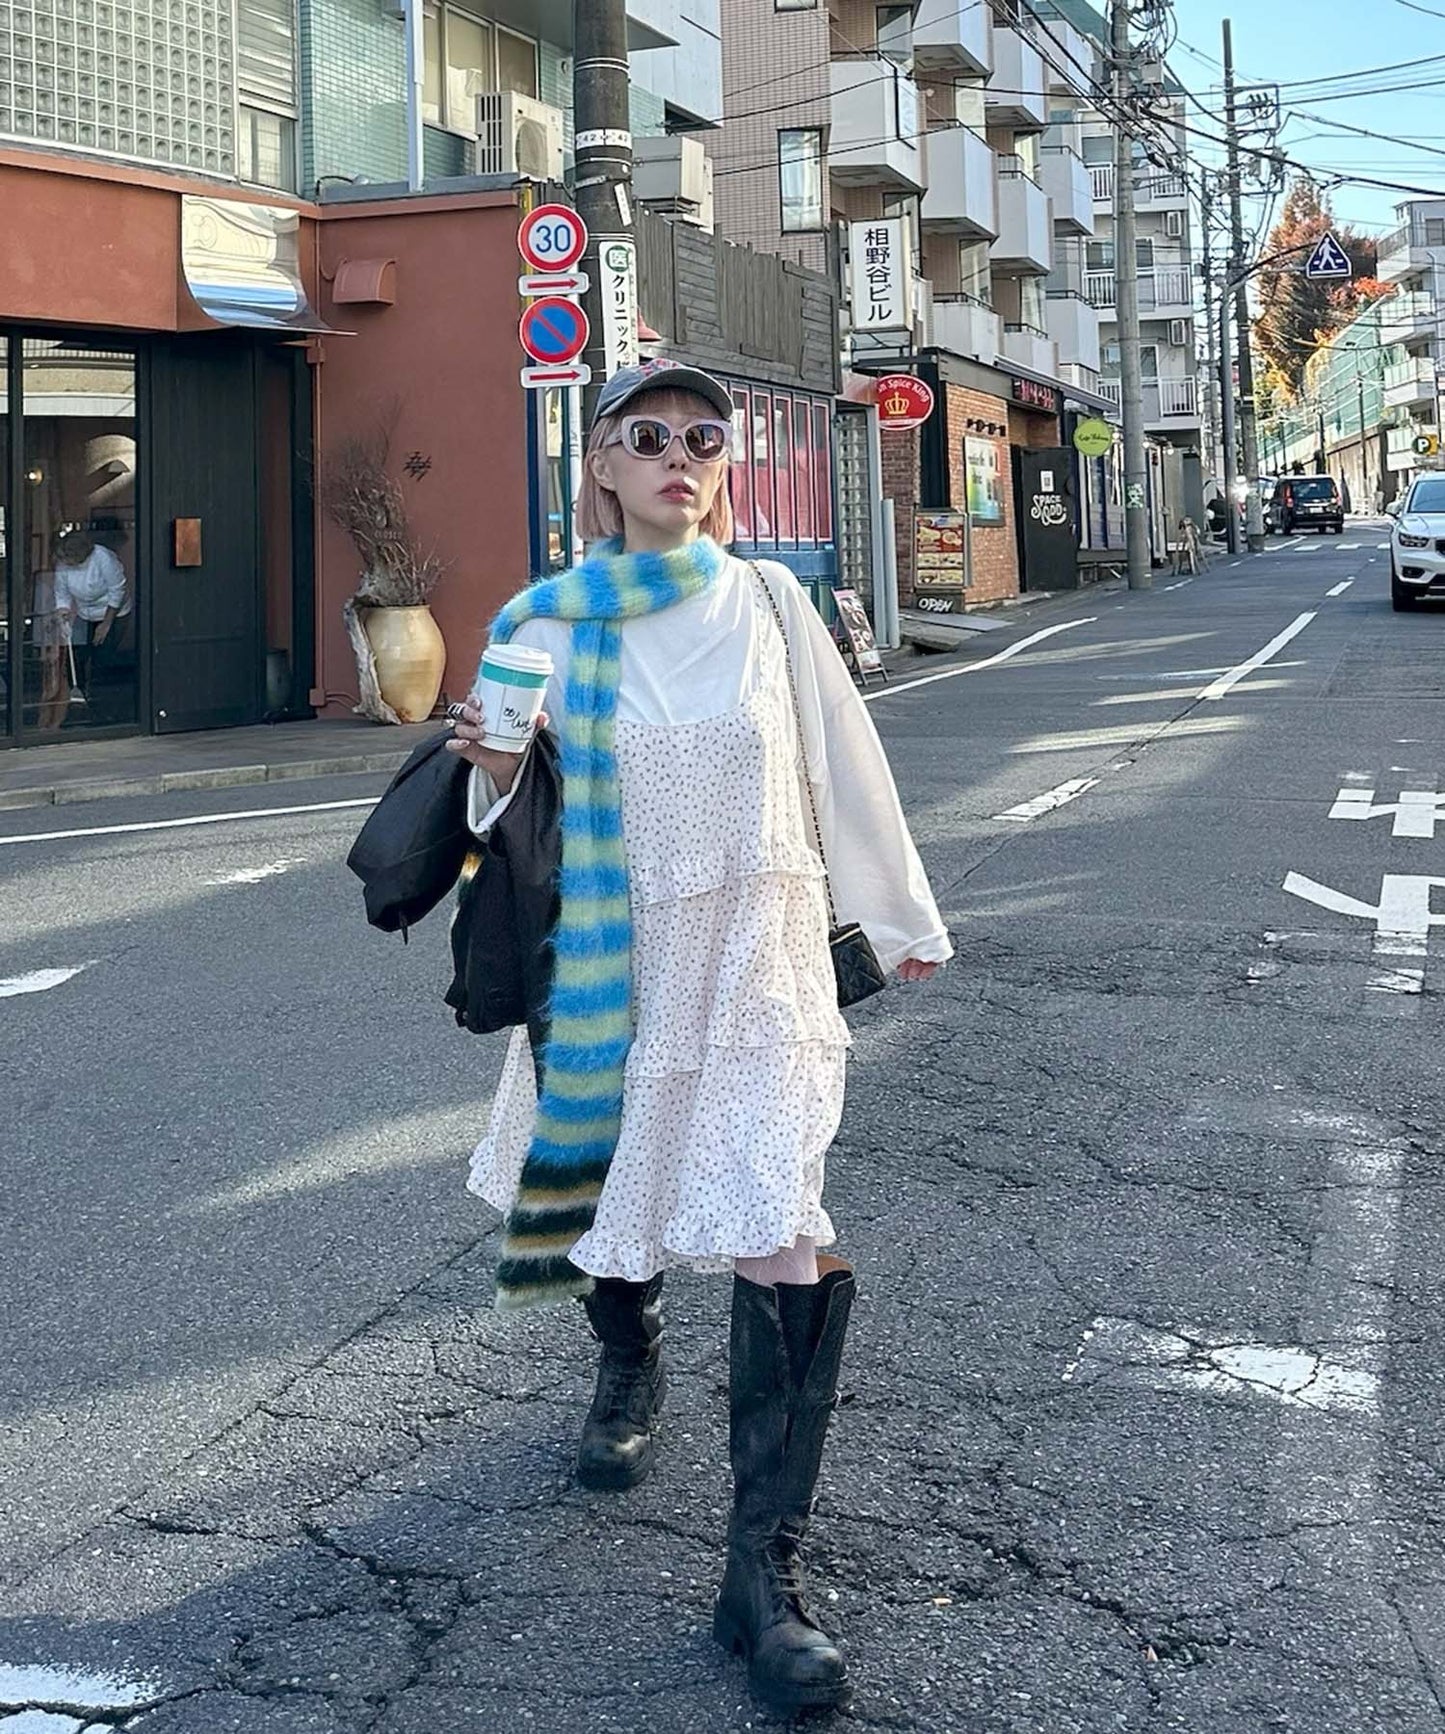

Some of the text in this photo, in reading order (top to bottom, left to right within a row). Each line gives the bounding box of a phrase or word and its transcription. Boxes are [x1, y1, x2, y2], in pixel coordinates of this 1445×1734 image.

[535, 224, 571, 253] 30
[864, 227, 893, 322] 相野谷ビル
[887, 378, 912, 390] Spice
[911, 383, 930, 403] King
[1417, 438, 1430, 453] P
[1031, 494, 1062, 519] SPACE
[918, 597, 954, 613] OPEN
